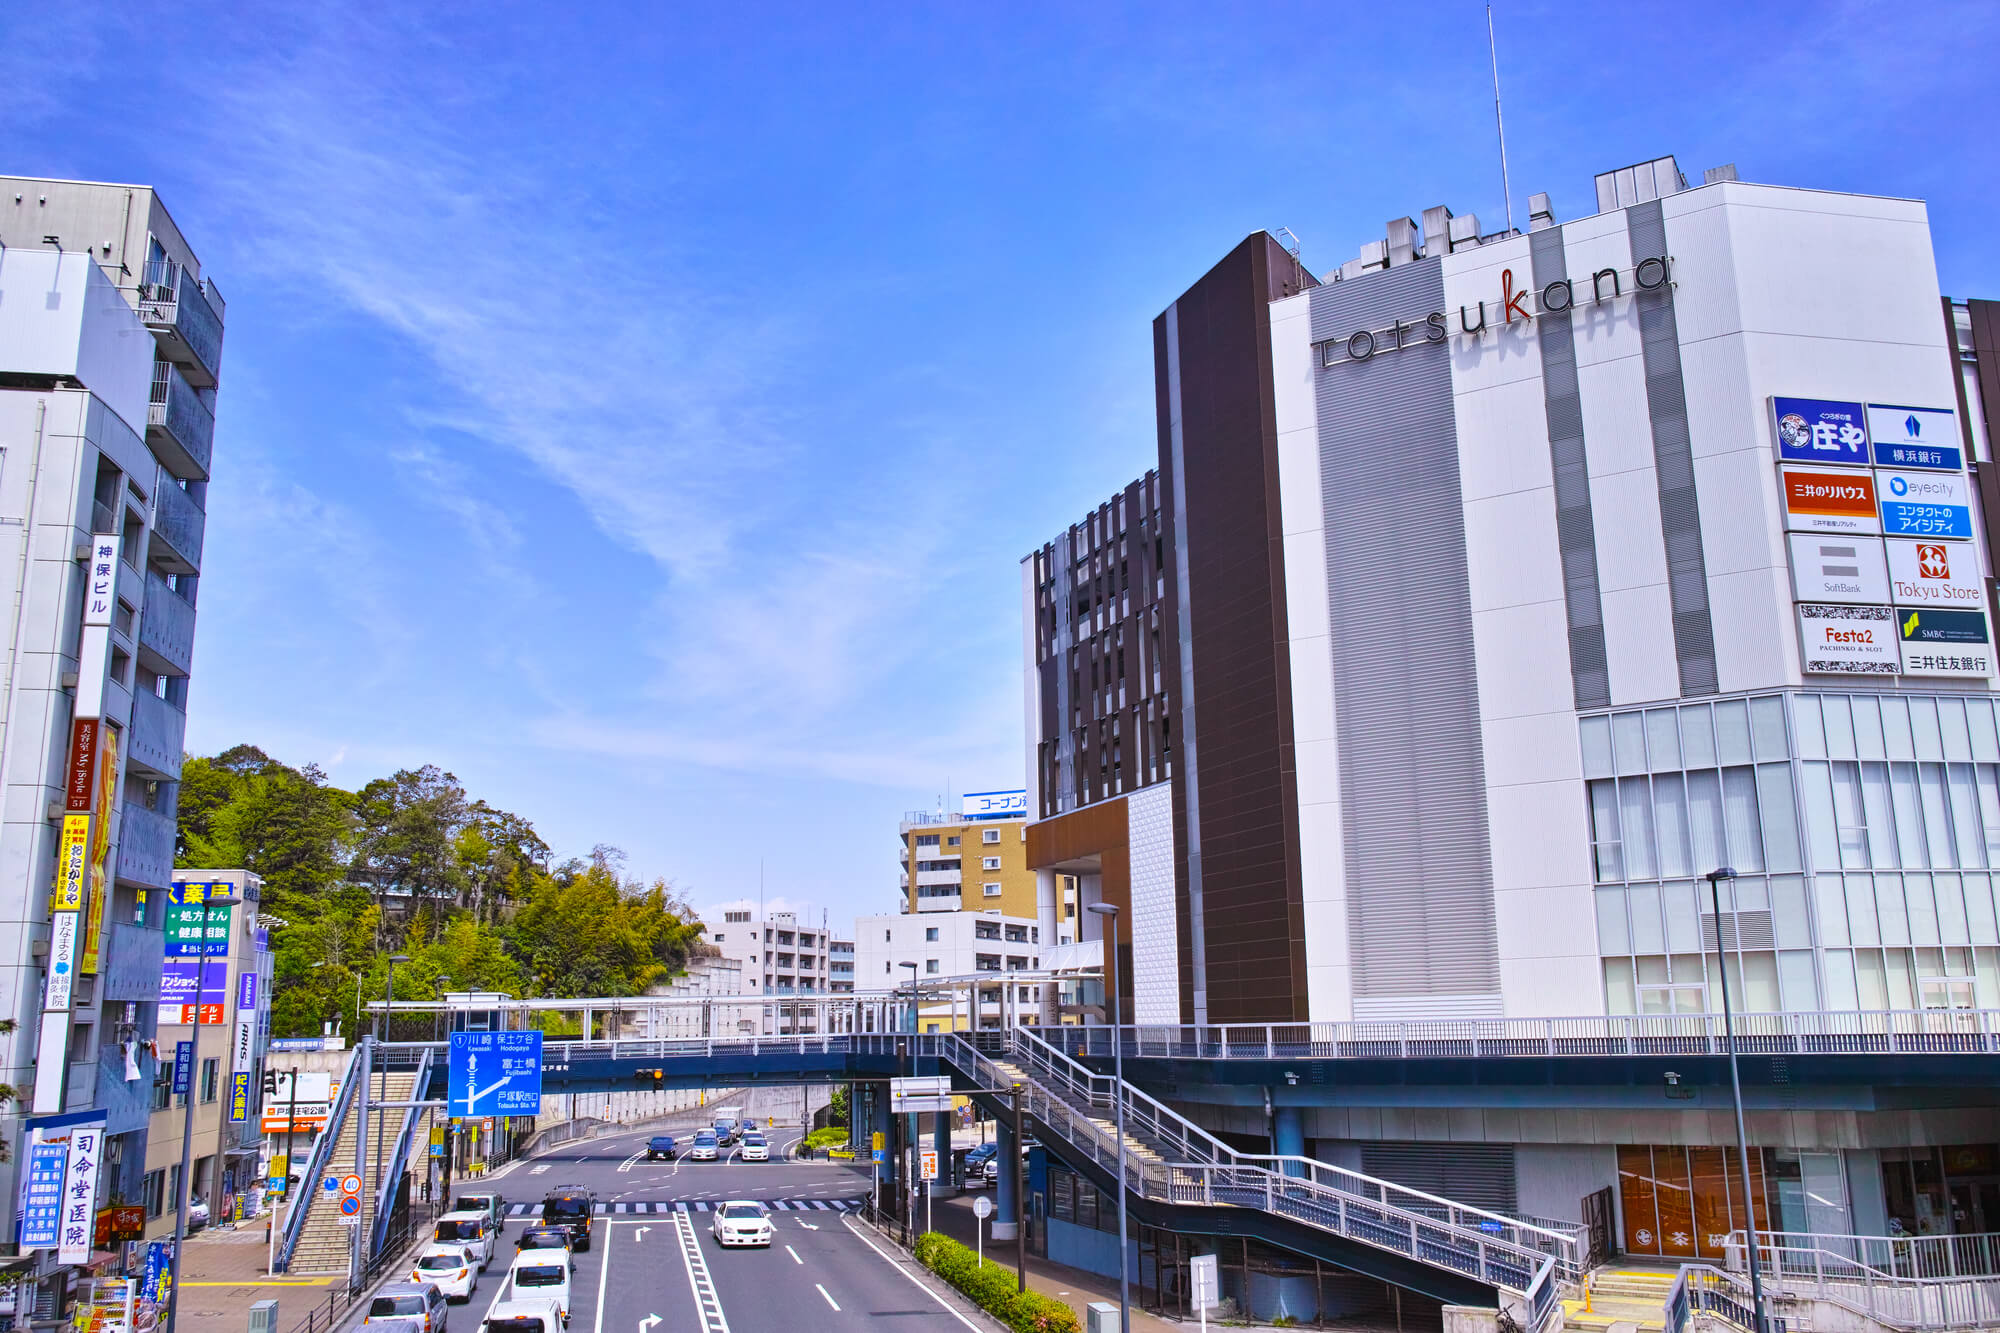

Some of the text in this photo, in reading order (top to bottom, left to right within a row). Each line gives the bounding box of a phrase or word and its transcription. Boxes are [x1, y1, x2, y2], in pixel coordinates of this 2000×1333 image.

[1309, 255, 1672, 368] Totsukana
[1811, 421, 1866, 453] 庄や
[1893, 449, 1942, 464] 横浜銀行
[1794, 484, 1867, 500] 三井のリハウス
[1909, 482, 1953, 498] eyecity
[1897, 505, 1953, 518] コンタクトの
[1898, 517, 1954, 533] アイシティ
[91, 545, 113, 613] 神保ビル
[1824, 582, 1861, 593] SoftBank
[1894, 581, 1980, 600] Tokyu Store
[1826, 627, 1874, 644] Festa2
[1922, 630, 1945, 638] SMBC
[1909, 655, 1986, 671] 三井住友銀行
[65, 844, 83, 904] おたからや
[57, 915, 72, 961] はなまる
[240, 1023, 249, 1061] ARKS
[468, 1035, 492, 1045] 川崎
[502, 1058, 536, 1069] 富士橋
[232, 1074, 247, 1120] 紀久薬局
[498, 1091, 538, 1102] 戸塚駅西口
[65, 1135, 94, 1246] 司命堂医院
[346, 1180, 358, 1190] 40
